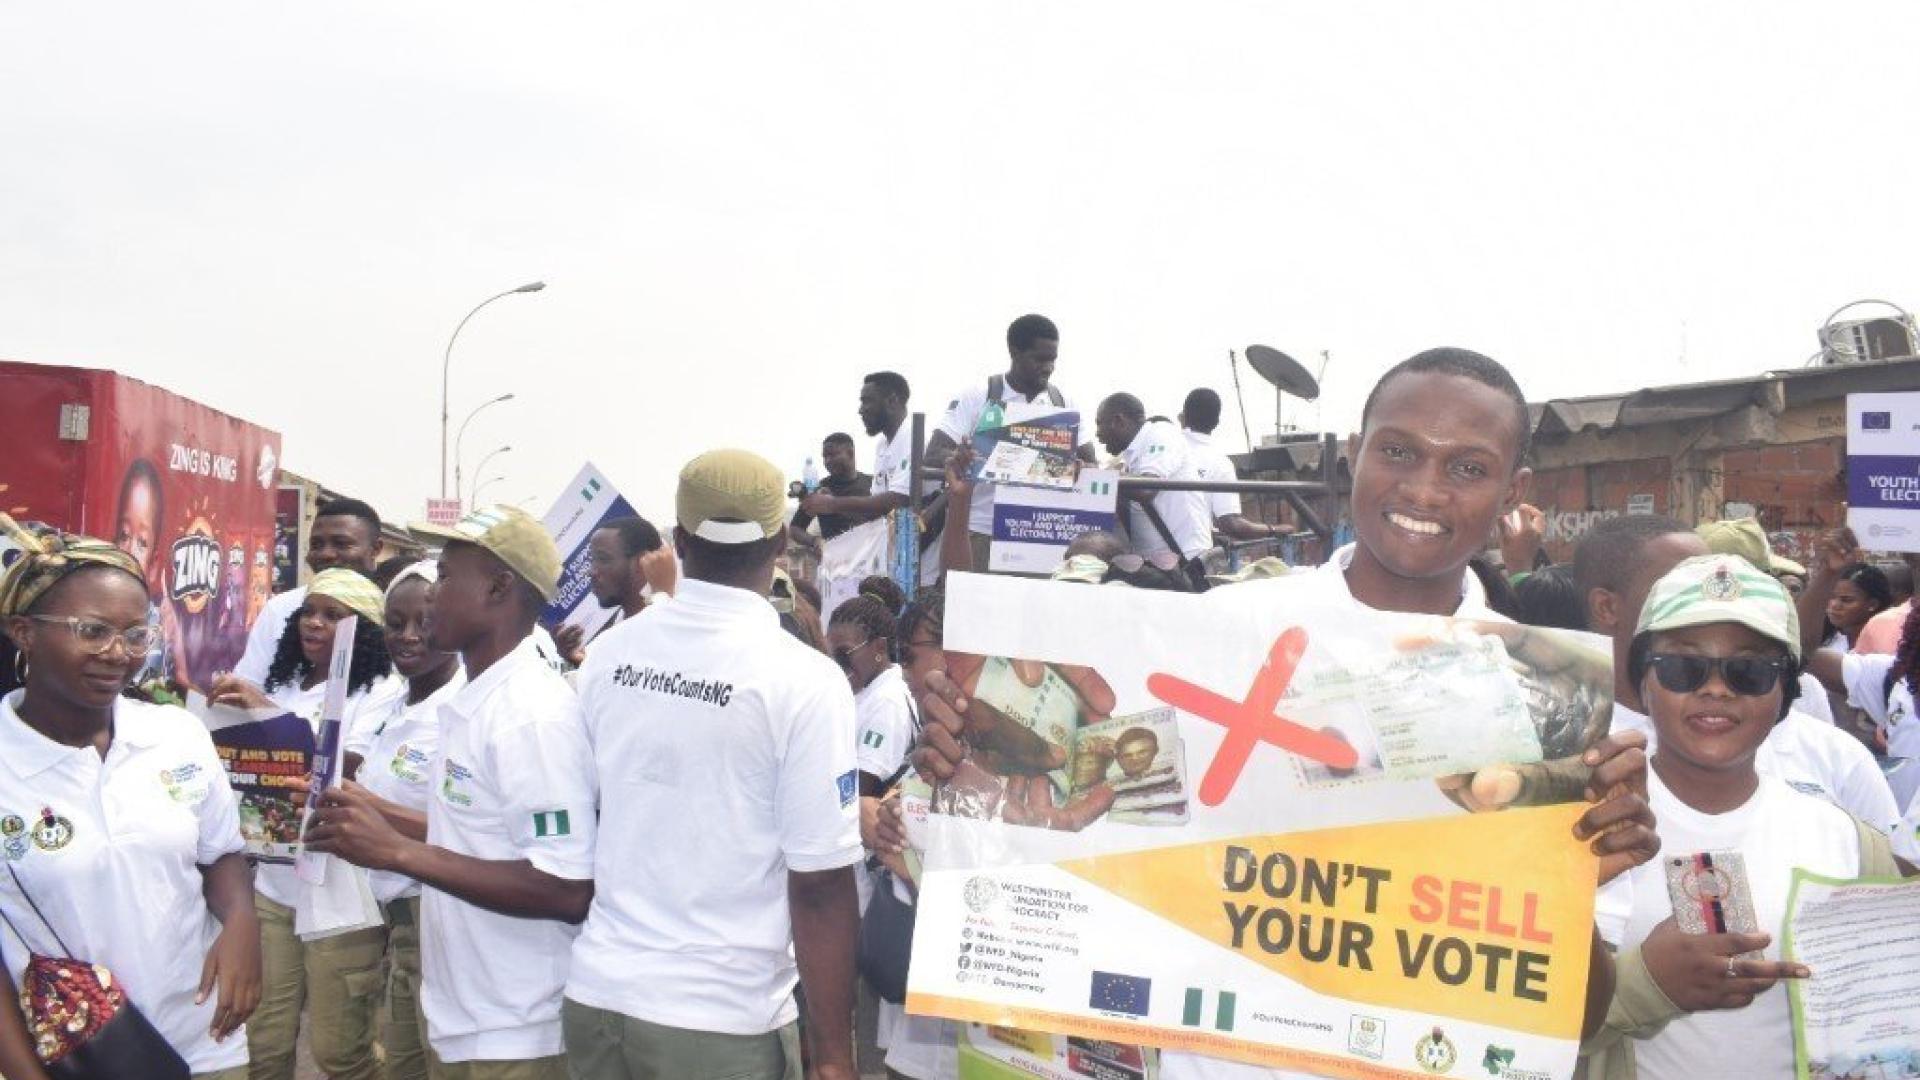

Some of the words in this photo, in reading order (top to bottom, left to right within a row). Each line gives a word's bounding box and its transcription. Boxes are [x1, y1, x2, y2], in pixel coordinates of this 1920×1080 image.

[170, 443, 198, 473] ZING
[200, 450, 211, 476] IS
[213, 454, 237, 481] KING
[1868, 476, 1918, 488] YOUTH
[1034, 521, 1052, 530] AND
[175, 543, 220, 591] ZING
[613, 664, 733, 707] #OurVoteCountsNG
[241, 748, 268, 761] AND
[271, 749, 304, 763] VOTE
[1224, 845, 1391, 913] DON'T
[1410, 875, 1553, 944] SELL
[1224, 901, 1373, 971] YOUR
[1395, 927, 1550, 1002] VOTE
